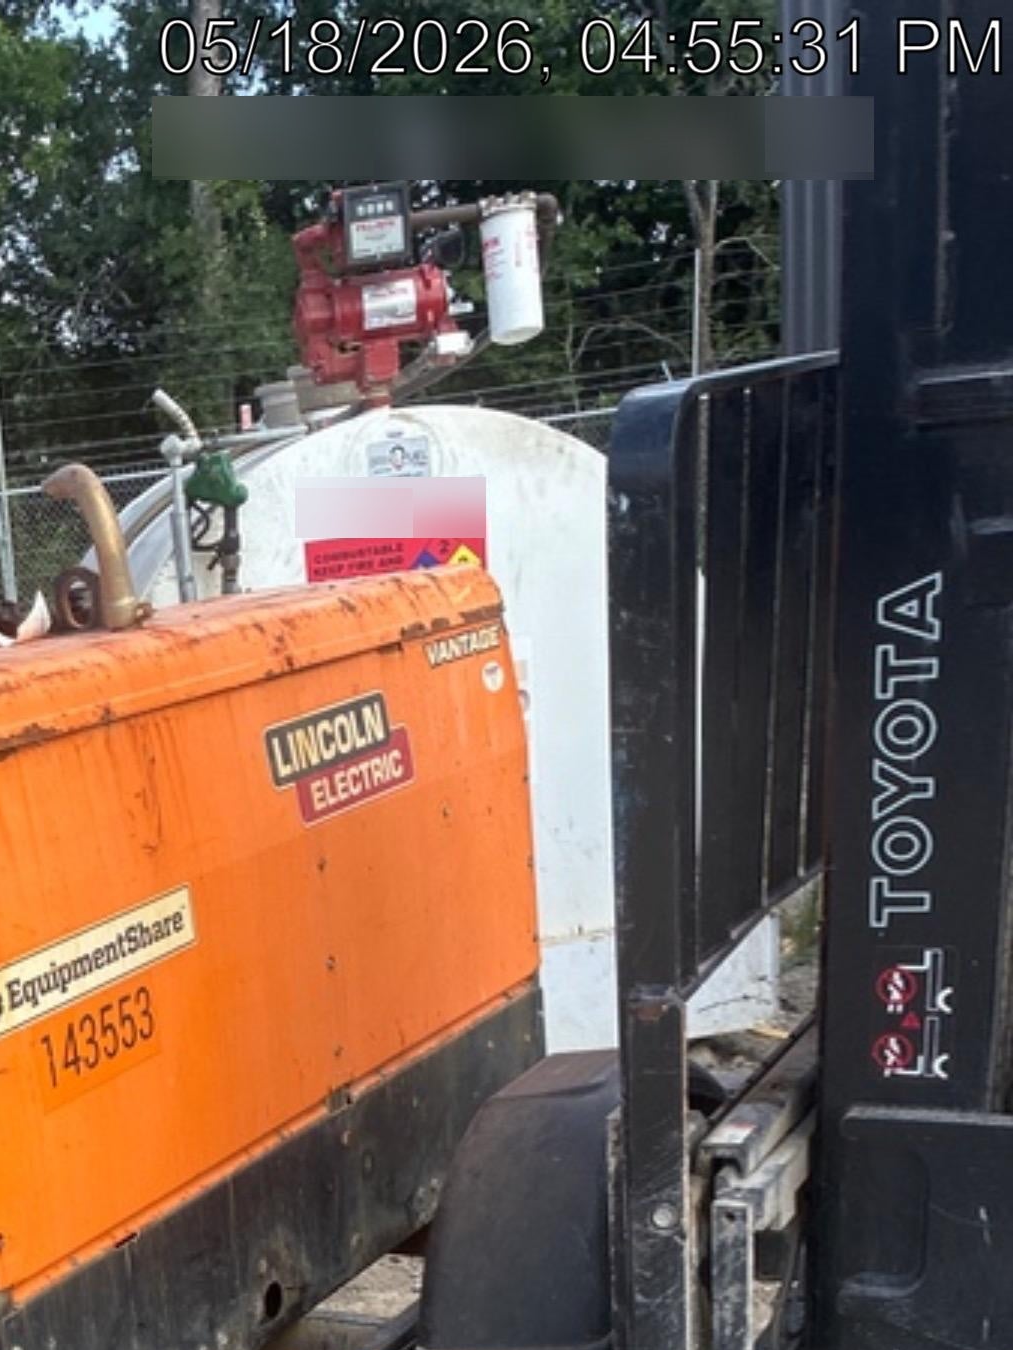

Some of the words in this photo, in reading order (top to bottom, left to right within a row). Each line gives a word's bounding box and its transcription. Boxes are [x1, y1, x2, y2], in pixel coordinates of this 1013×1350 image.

[426, 624, 500, 667] VANTAGE
[271, 702, 386, 778] LINCOLN
[309, 749, 405, 812] ELECTRIC
[870, 570, 943, 929] TOYOTA
[5, 911, 185, 1012] EquipmentShare
[40, 987, 156, 1088] 143553
